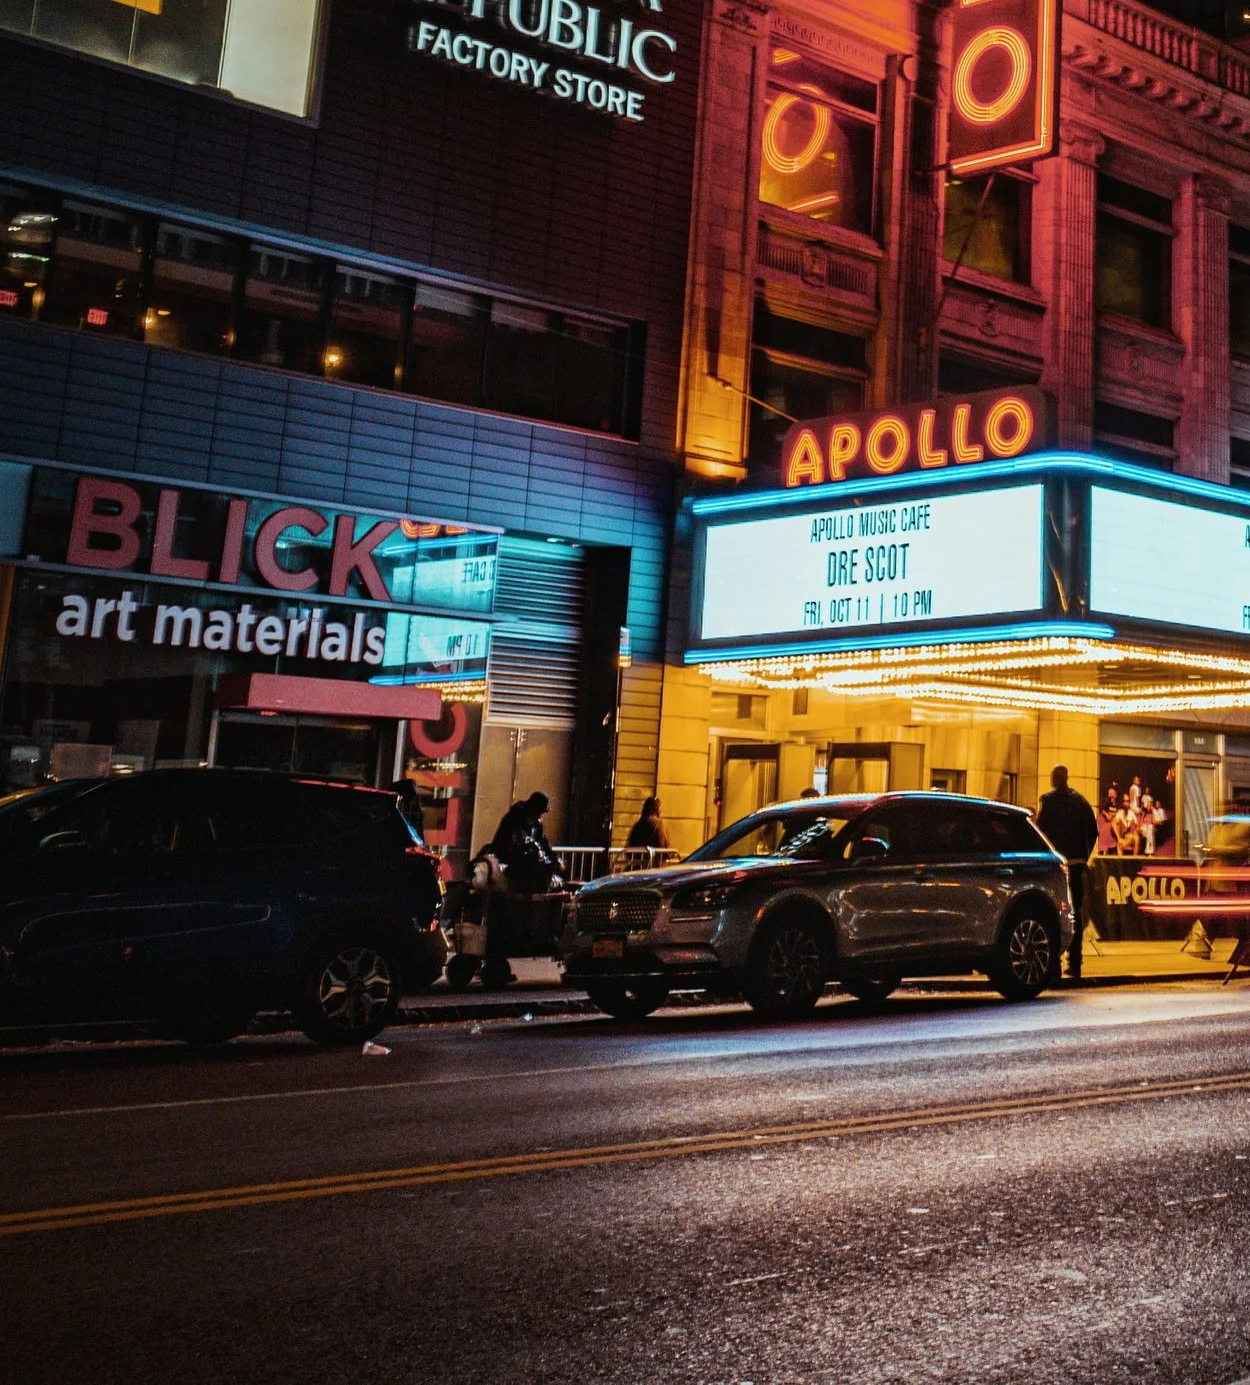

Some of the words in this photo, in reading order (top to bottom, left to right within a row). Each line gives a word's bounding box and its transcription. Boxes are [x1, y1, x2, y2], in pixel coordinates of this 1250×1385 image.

[417, 21, 550, 88] FACTORY
[553, 69, 645, 121] STORE
[786, 397, 1033, 488] APOLLO
[66, 476, 401, 602] BLICK
[810, 518, 854, 543] APOLLO
[858, 510, 897, 537] MUSIC
[900, 504, 931, 531] CAFE
[826, 548, 859, 588] DRE
[865, 543, 910, 583] SCOT
[56, 591, 141, 642] art
[152, 604, 386, 664] materials
[803, 599, 824, 629] FRI,
[829, 597, 852, 625] OCT
[857, 596, 870, 621] 11
[893, 593, 909, 619] 10
[913, 590, 932, 616] PM
[1106, 876, 1185, 905] APOLLO
